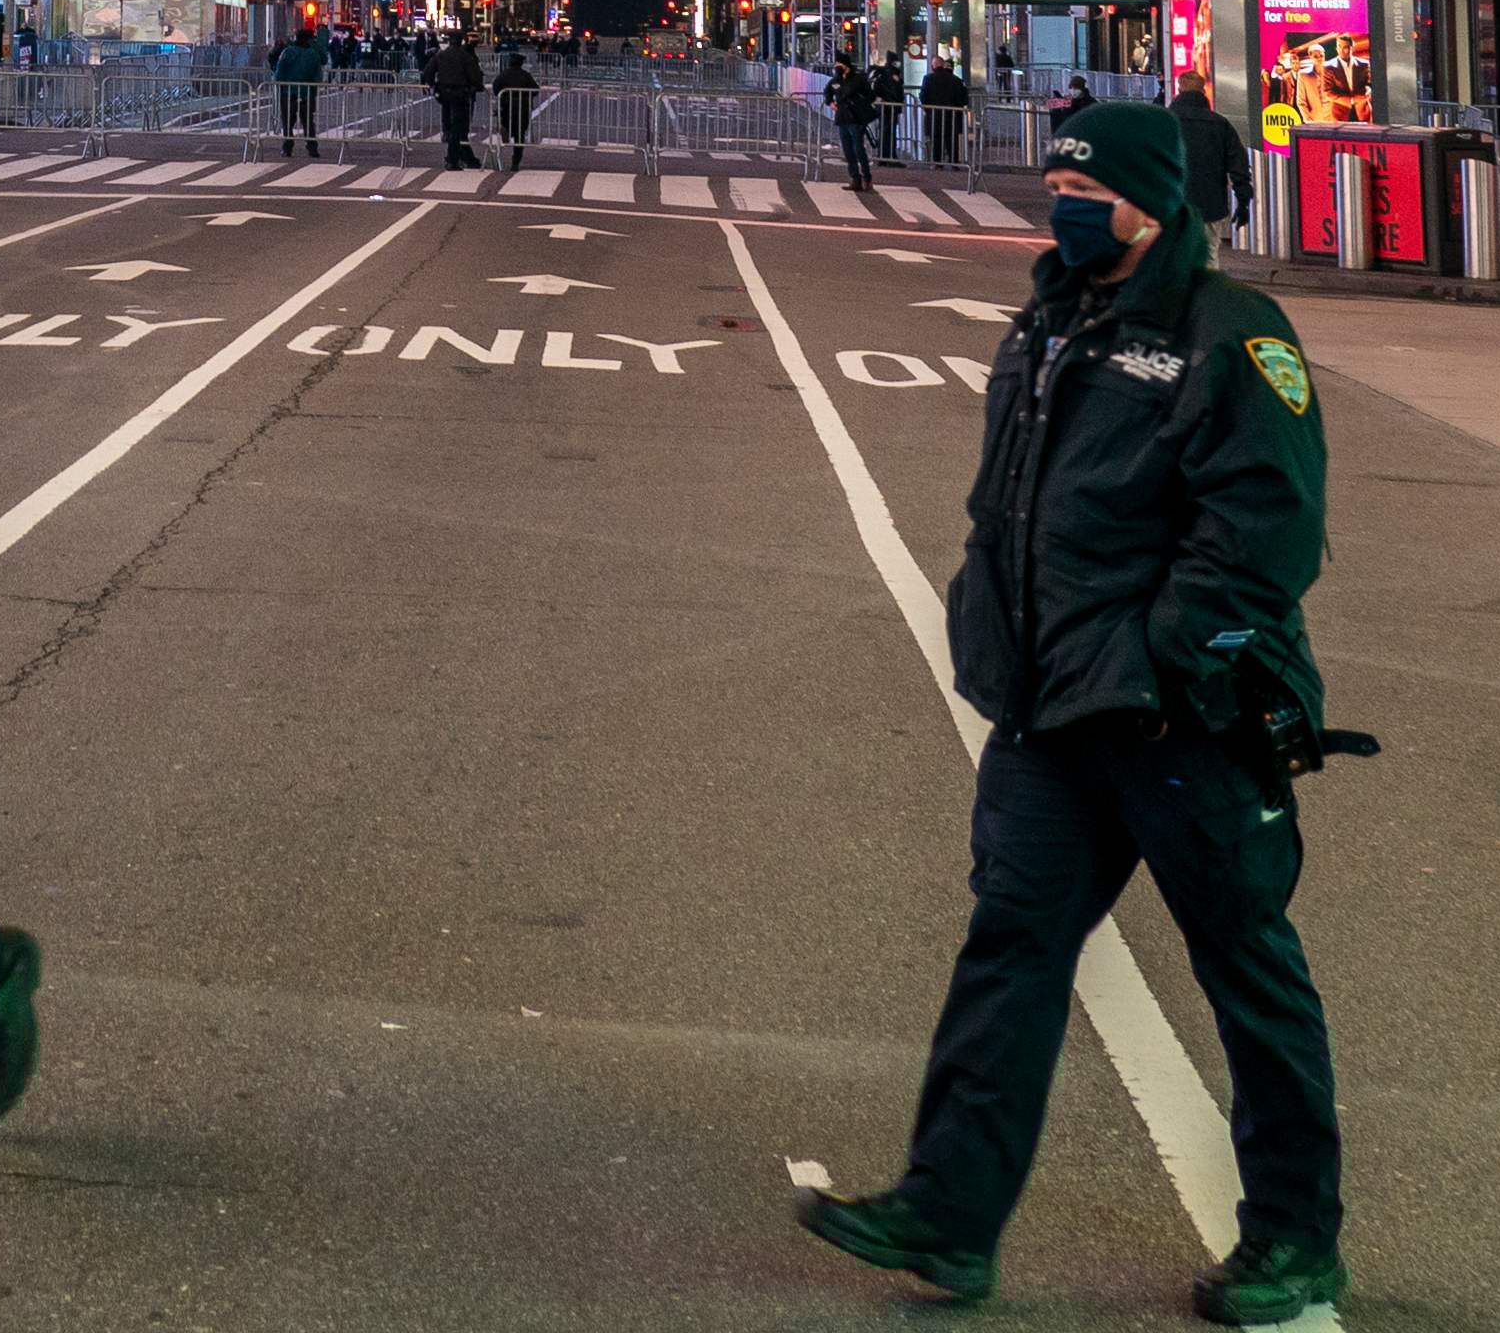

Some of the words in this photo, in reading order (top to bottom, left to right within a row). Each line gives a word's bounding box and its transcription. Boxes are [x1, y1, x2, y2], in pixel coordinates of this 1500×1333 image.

[1263, 9, 1283, 23] for
[1285, 9, 1311, 24] free
[1265, 113, 1295, 128] IMDb
[287, 324, 724, 375] ONLY
[1122, 342, 1185, 377] OLICE
